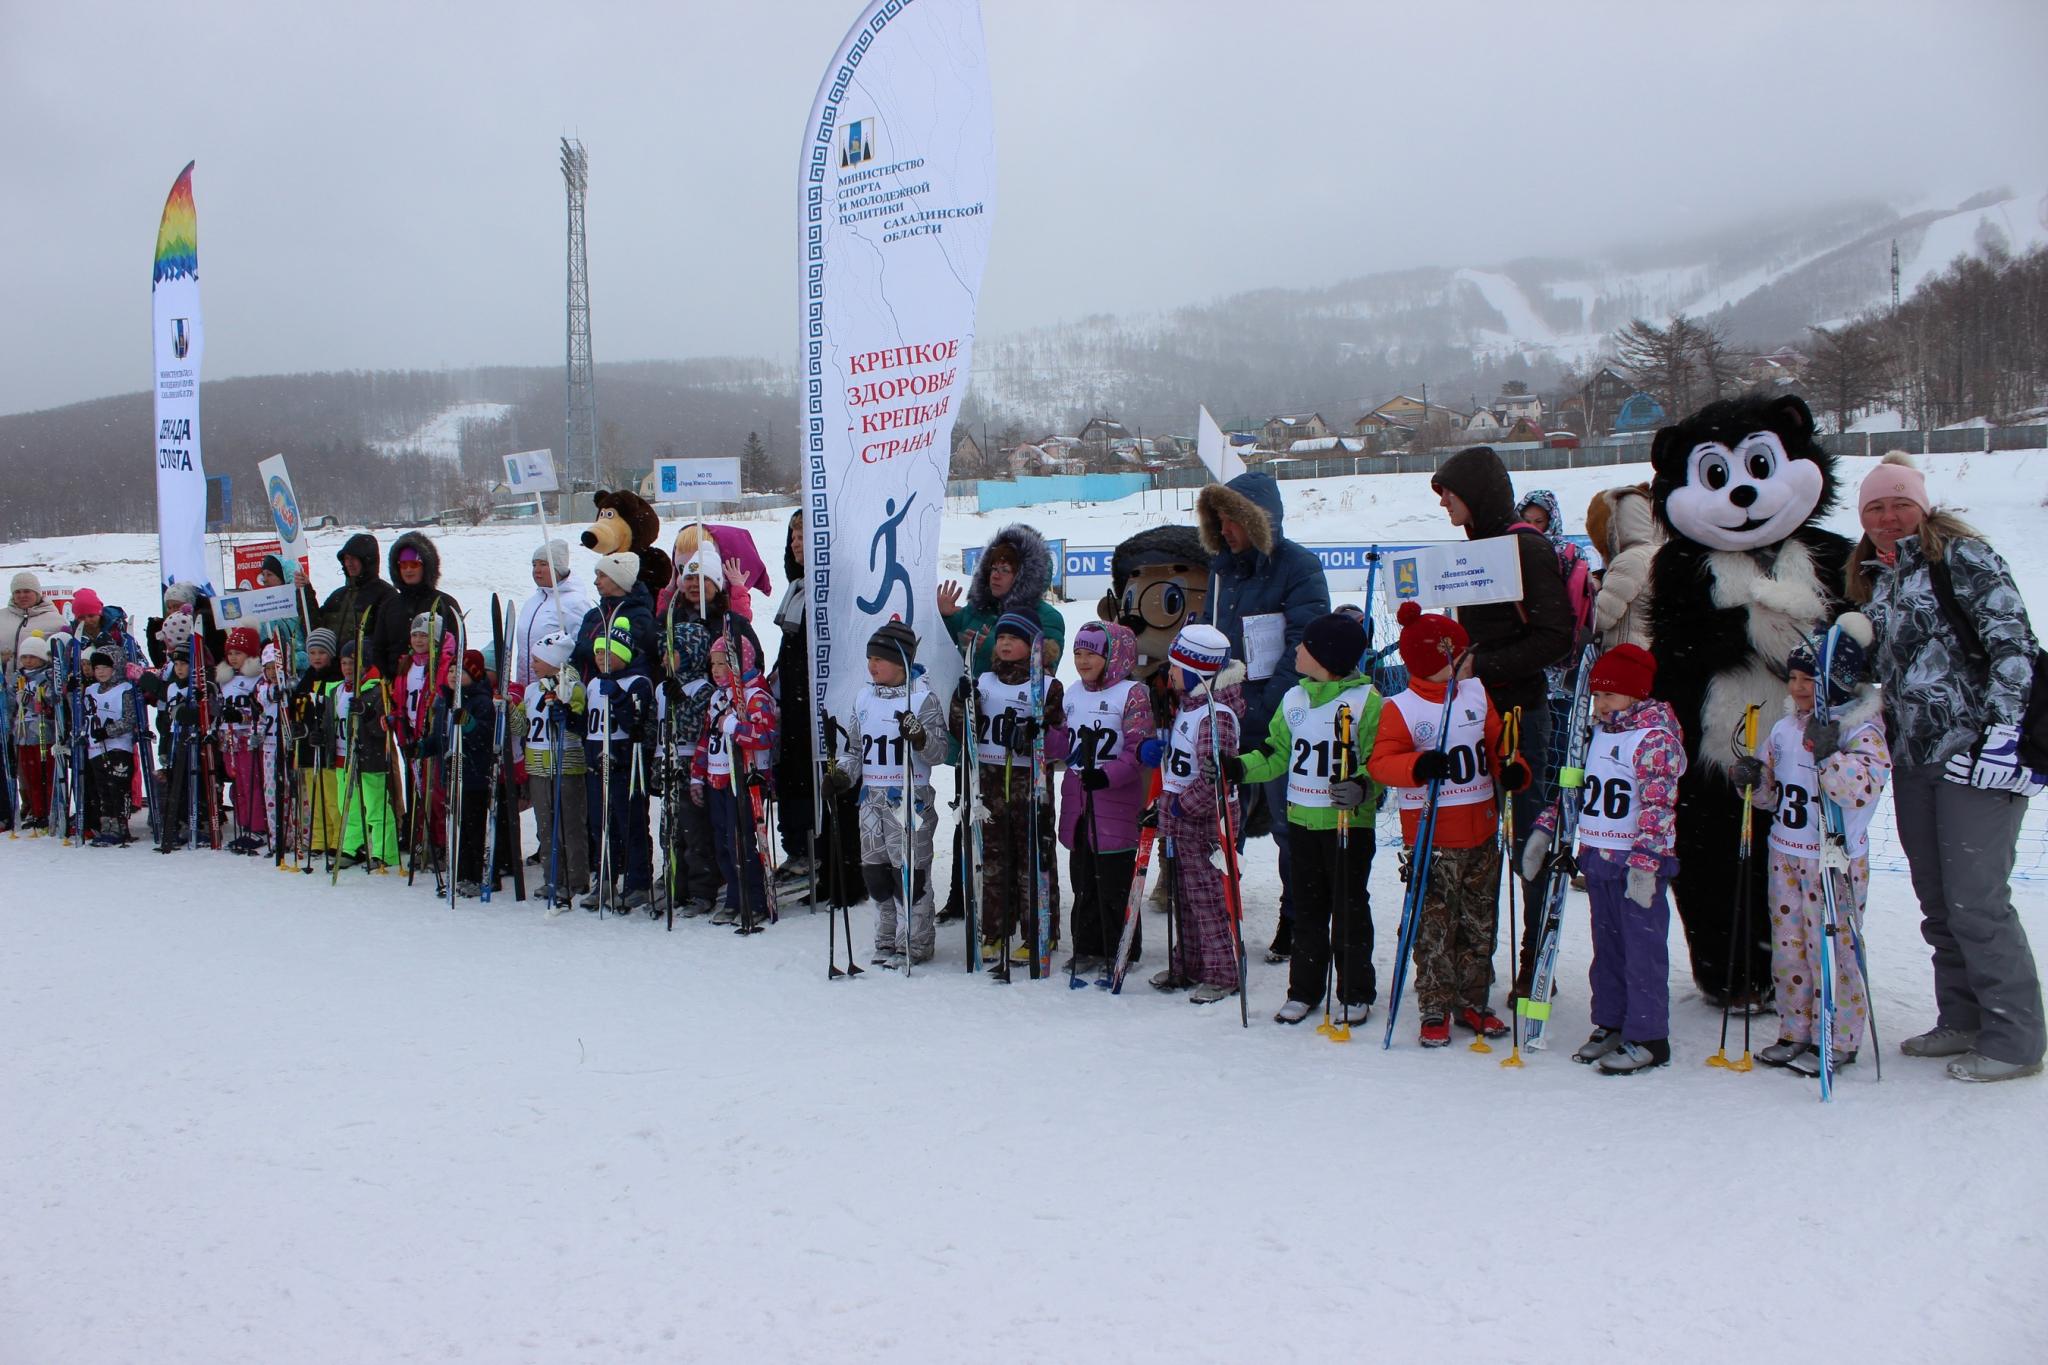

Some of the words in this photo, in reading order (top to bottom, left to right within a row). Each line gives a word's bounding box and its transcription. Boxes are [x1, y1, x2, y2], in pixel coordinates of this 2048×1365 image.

[838, 158, 925, 187] МИНИСТЕРСТВО
[838, 182, 882, 200] СПОРТА
[838, 202, 848, 213] И
[850, 181, 931, 210] МОЛОДЕЖНОЙ
[839, 202, 904, 226] ПОЛИТИКИ
[883, 202, 984, 230] САХАЛИНСКОЙ
[883, 224, 942, 244] ОБЛАСТИ
[849, 339, 958, 375] КРЕПКОЕ
[847, 367, 957, 408] ЗДОРОВЬЕ
[861, 395, 950, 434] КРЕПКАЯ
[159, 448, 193, 471] СПОРТА
[861, 428, 937, 464] СТРАНА!
[1319, 551, 1355, 567] ЛОН
[1570, 695, 1589, 760] Larsen
[1583, 775, 1633, 820] 26
